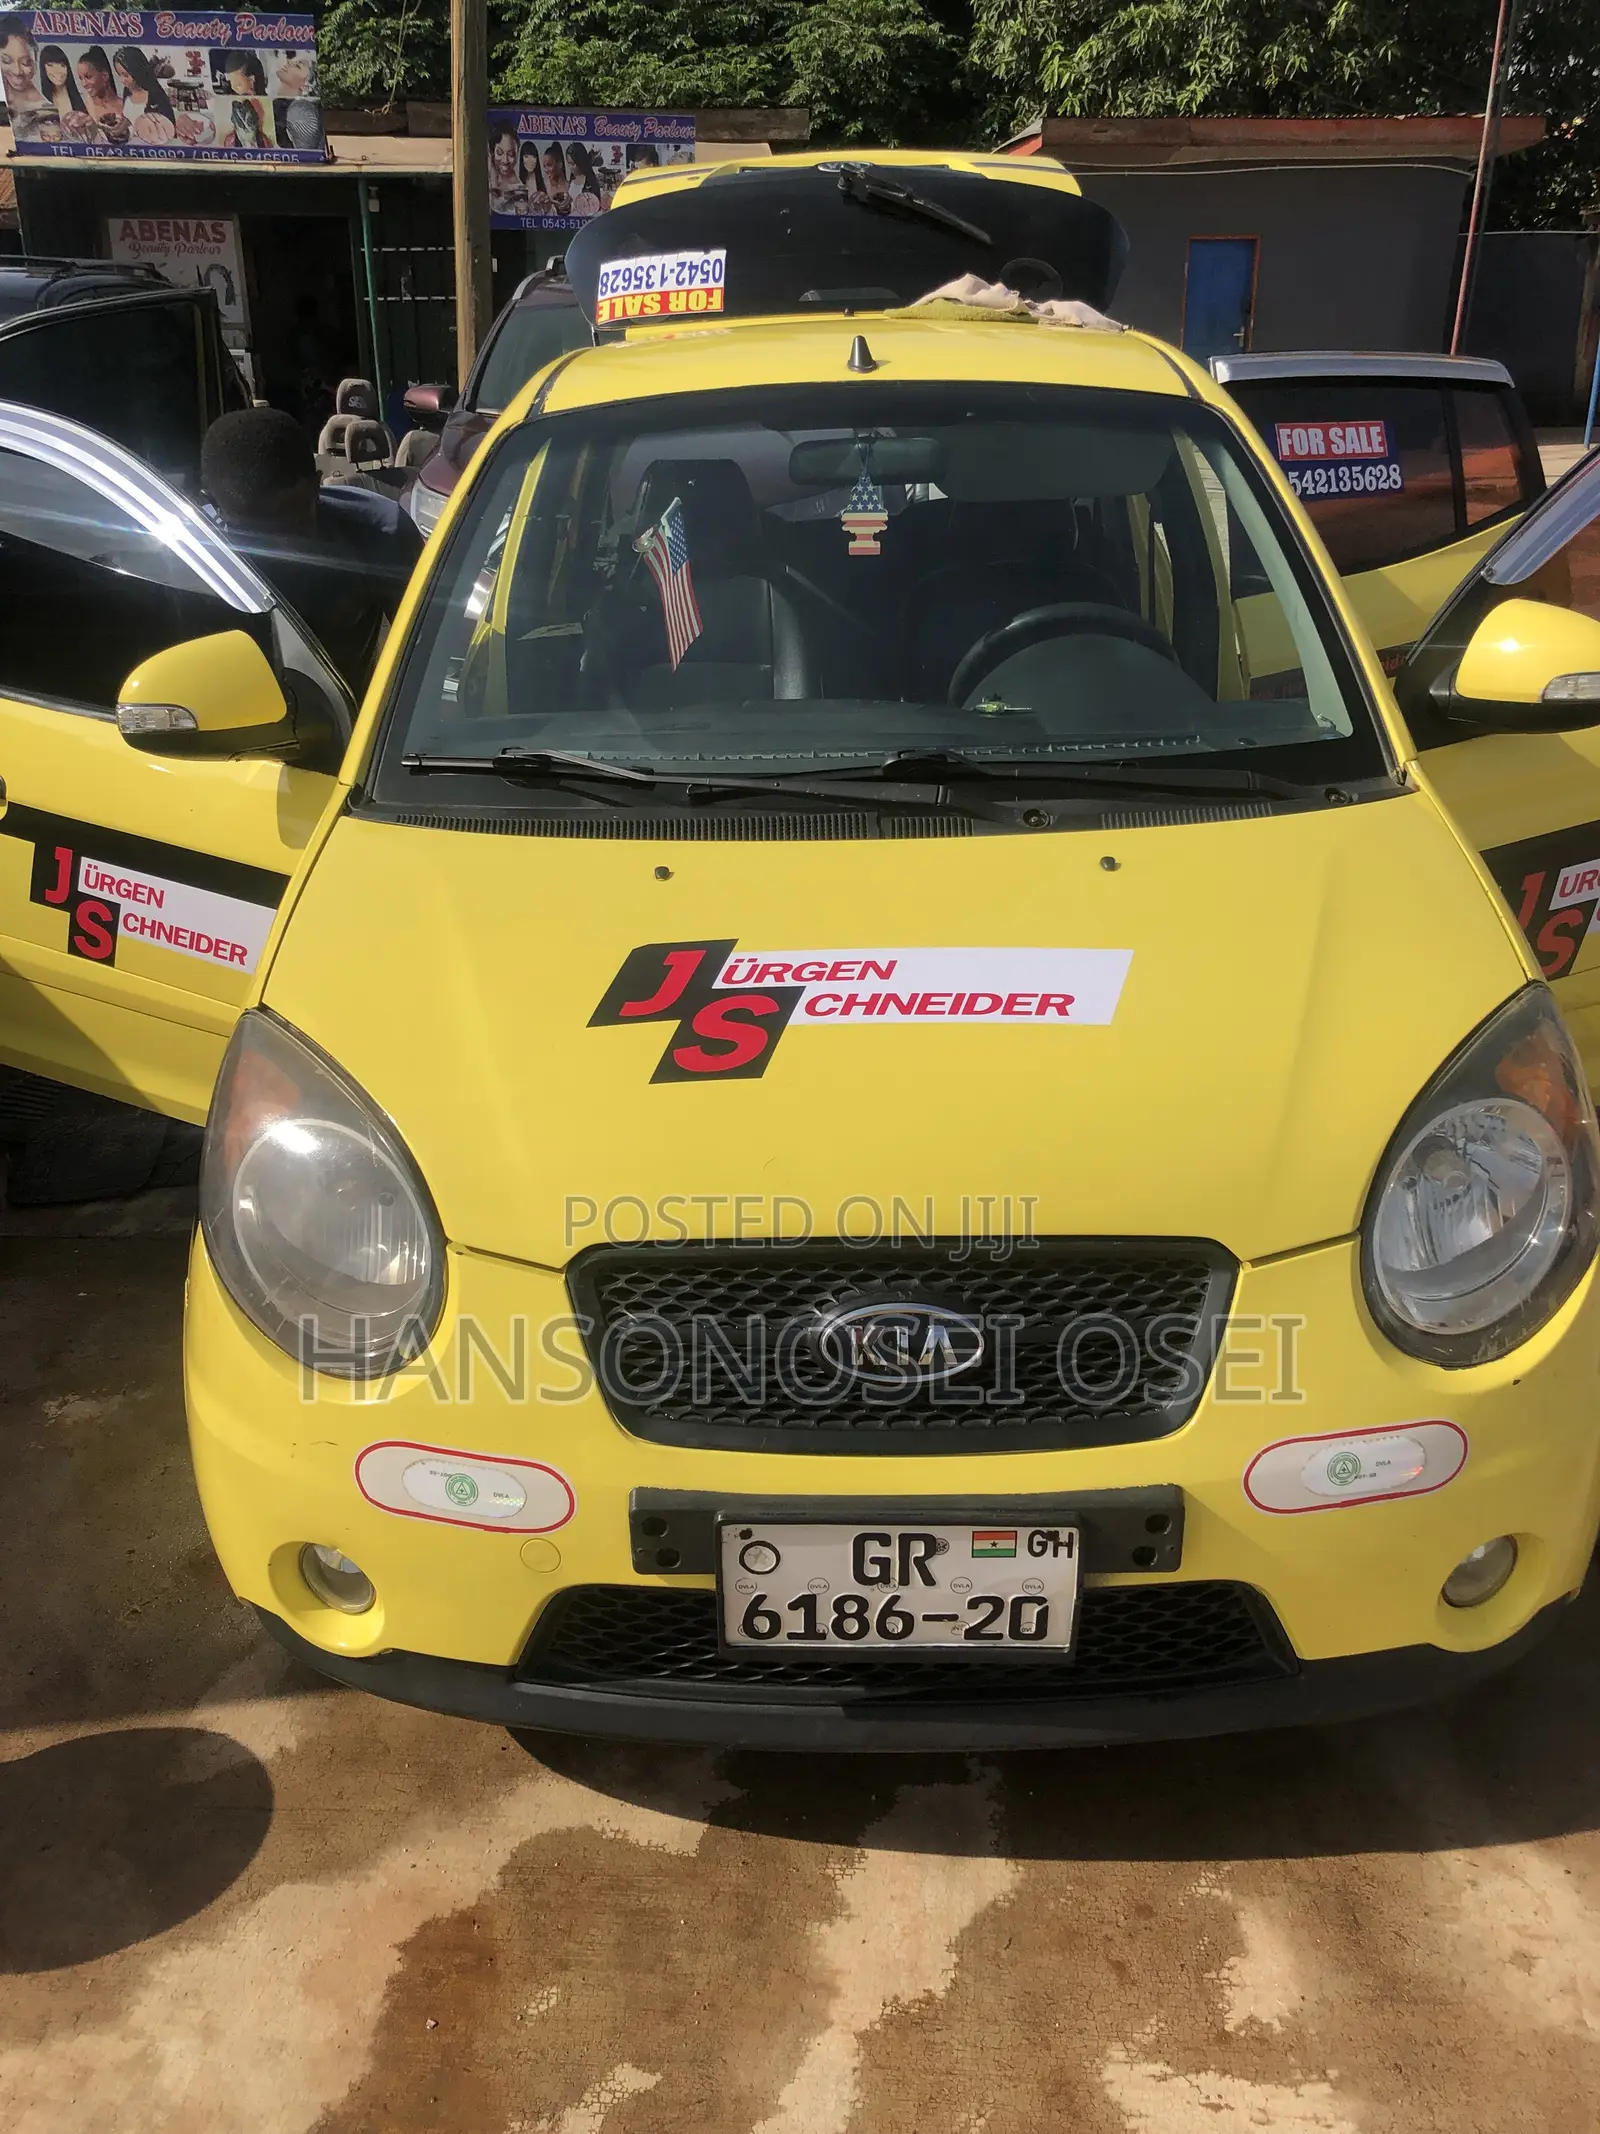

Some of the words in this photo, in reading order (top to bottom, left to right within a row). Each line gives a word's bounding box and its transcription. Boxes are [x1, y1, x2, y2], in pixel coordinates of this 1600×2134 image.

[31, 10, 143, 37] ABENA'S
[154, 12, 232, 45] Beauty
[234, 12, 317, 43] Parlour
[517, 114, 587, 136] ABENA'S
[593, 115, 642, 142] Beauty
[643, 117, 695, 139] Parlour
[120, 220, 226, 243] ABENAS
[542, 217, 591, 229] 0543-519
[599, 258, 723, 297] 0542-135628
[596, 293, 661, 323] SALE
[667, 289, 722, 313] FOR
[1278, 427, 1326, 457] FOR
[1328, 425, 1384, 454] SALE
[848, 1324, 959, 1367] KIA
[852, 1532, 937, 1587] GR
[1027, 1529, 1074, 1559] GH
[742, 1594, 1049, 1641] 6186-20
